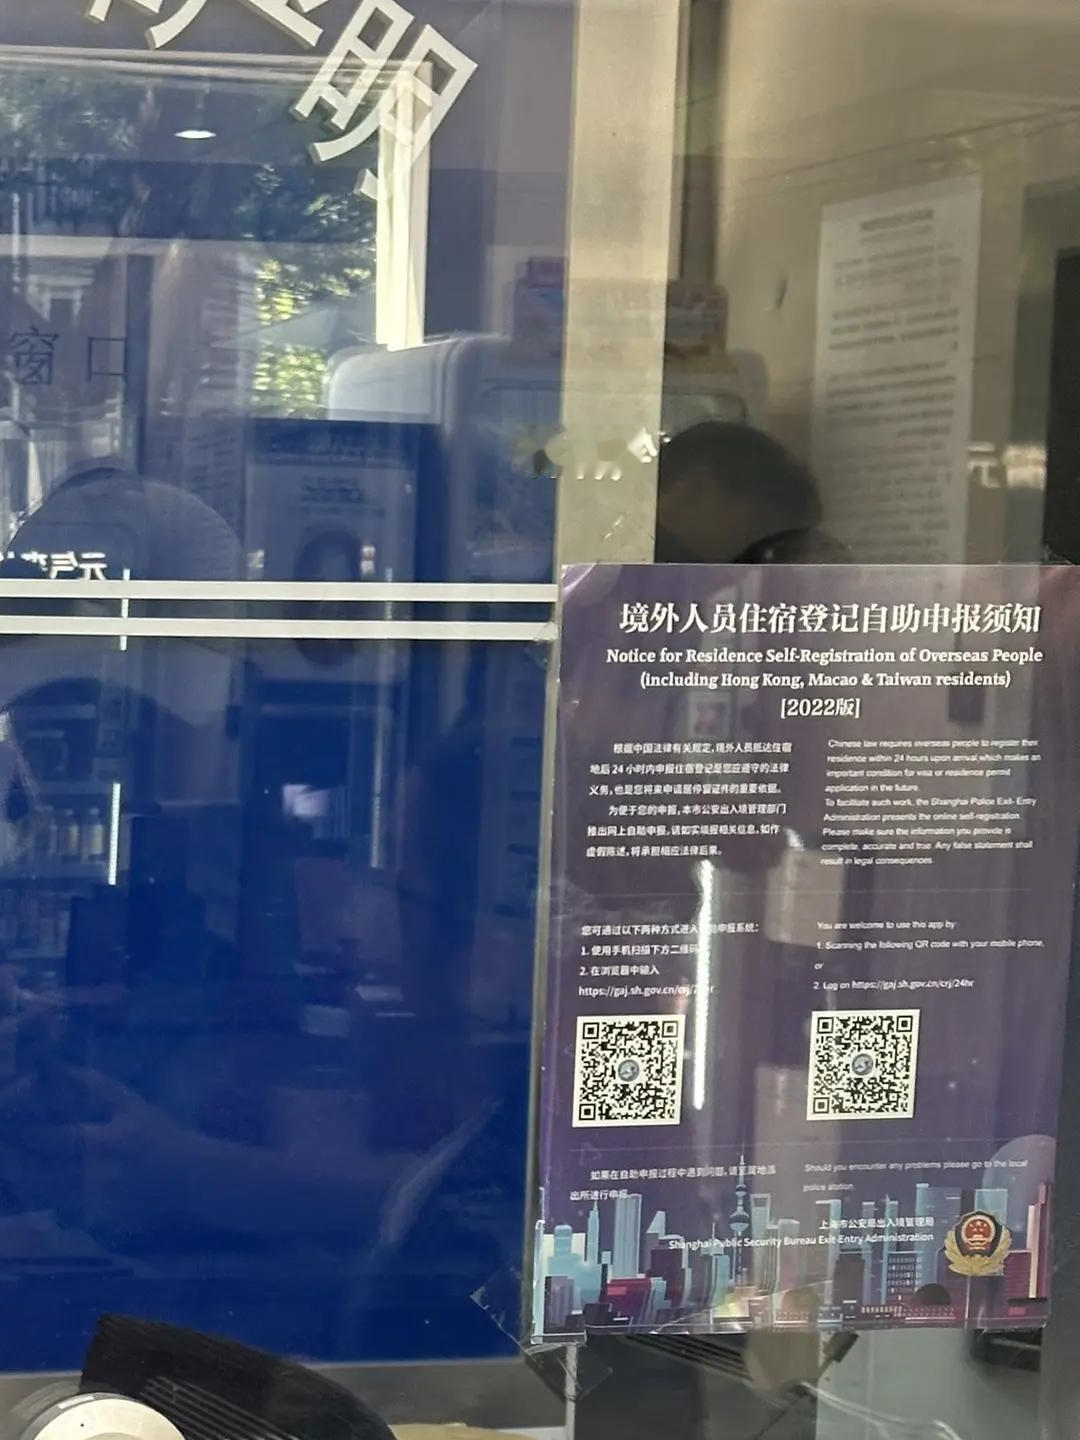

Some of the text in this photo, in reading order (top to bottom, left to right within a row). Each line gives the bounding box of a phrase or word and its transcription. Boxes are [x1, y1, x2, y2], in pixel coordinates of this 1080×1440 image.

[619, 602, 1042, 634] 境外人员住宿登记自助申报须知
[606, 646, 1044, 665] Notice for Residence Self-Registration of Overseas People
[640, 672, 1012, 690] (including Hong Kong, Macao & Taiwan residents)
[780, 697, 861, 719] [2022版]
[668, 1236, 712, 1252] Shanghai
[744, 1234, 781, 1250] Security
[783, 1233, 816, 1246] Bureau
[864, 1230, 934, 1244] Administration
